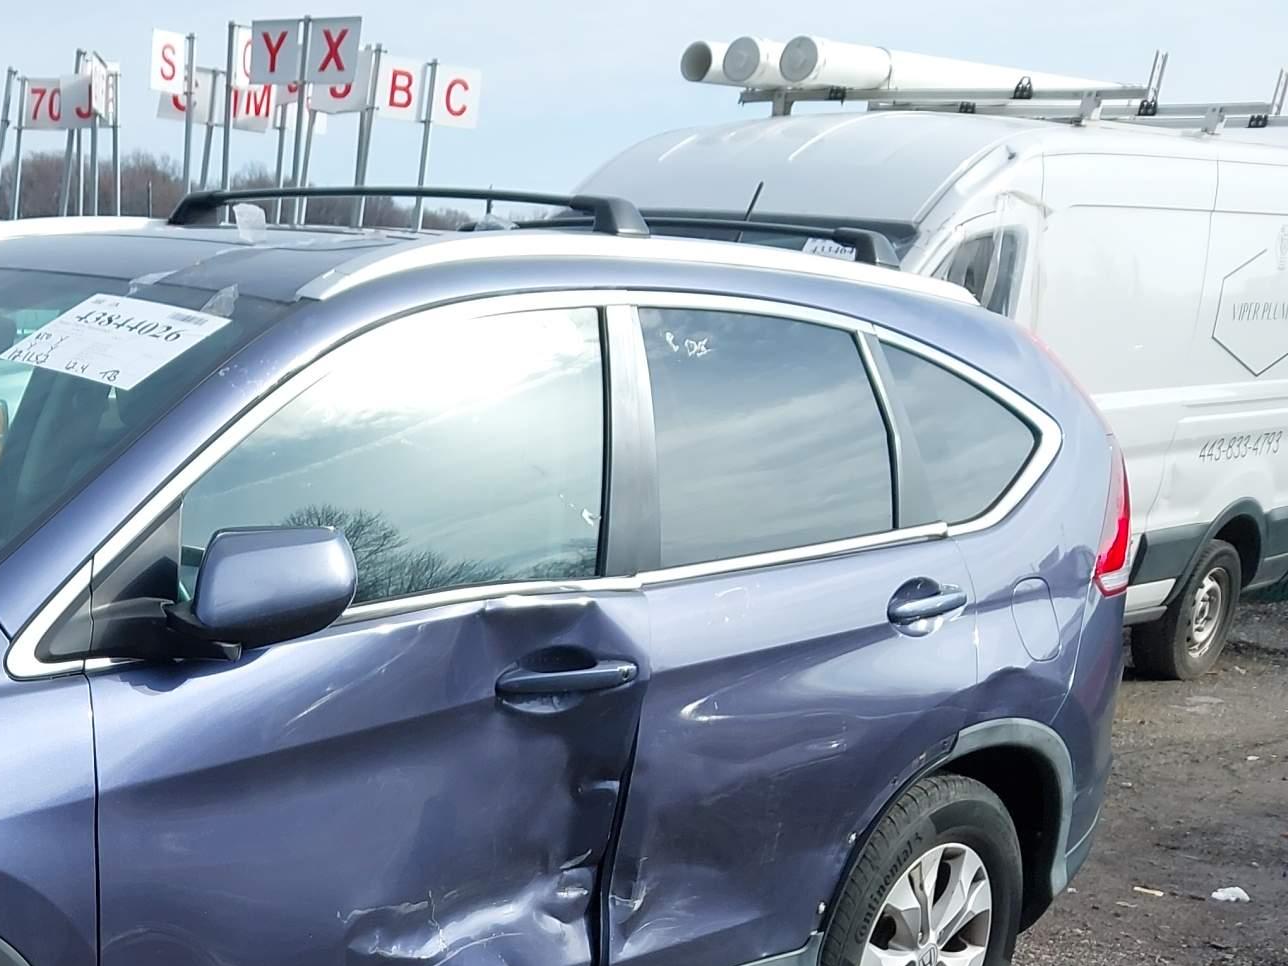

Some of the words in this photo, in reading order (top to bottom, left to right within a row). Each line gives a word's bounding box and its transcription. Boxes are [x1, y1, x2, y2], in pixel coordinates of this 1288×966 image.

[160, 43, 176, 81] S
[262, 30, 289, 74] Y
[317, 28, 349, 73] X
[388, 68, 413, 109] B
[444, 78, 470, 117] C
